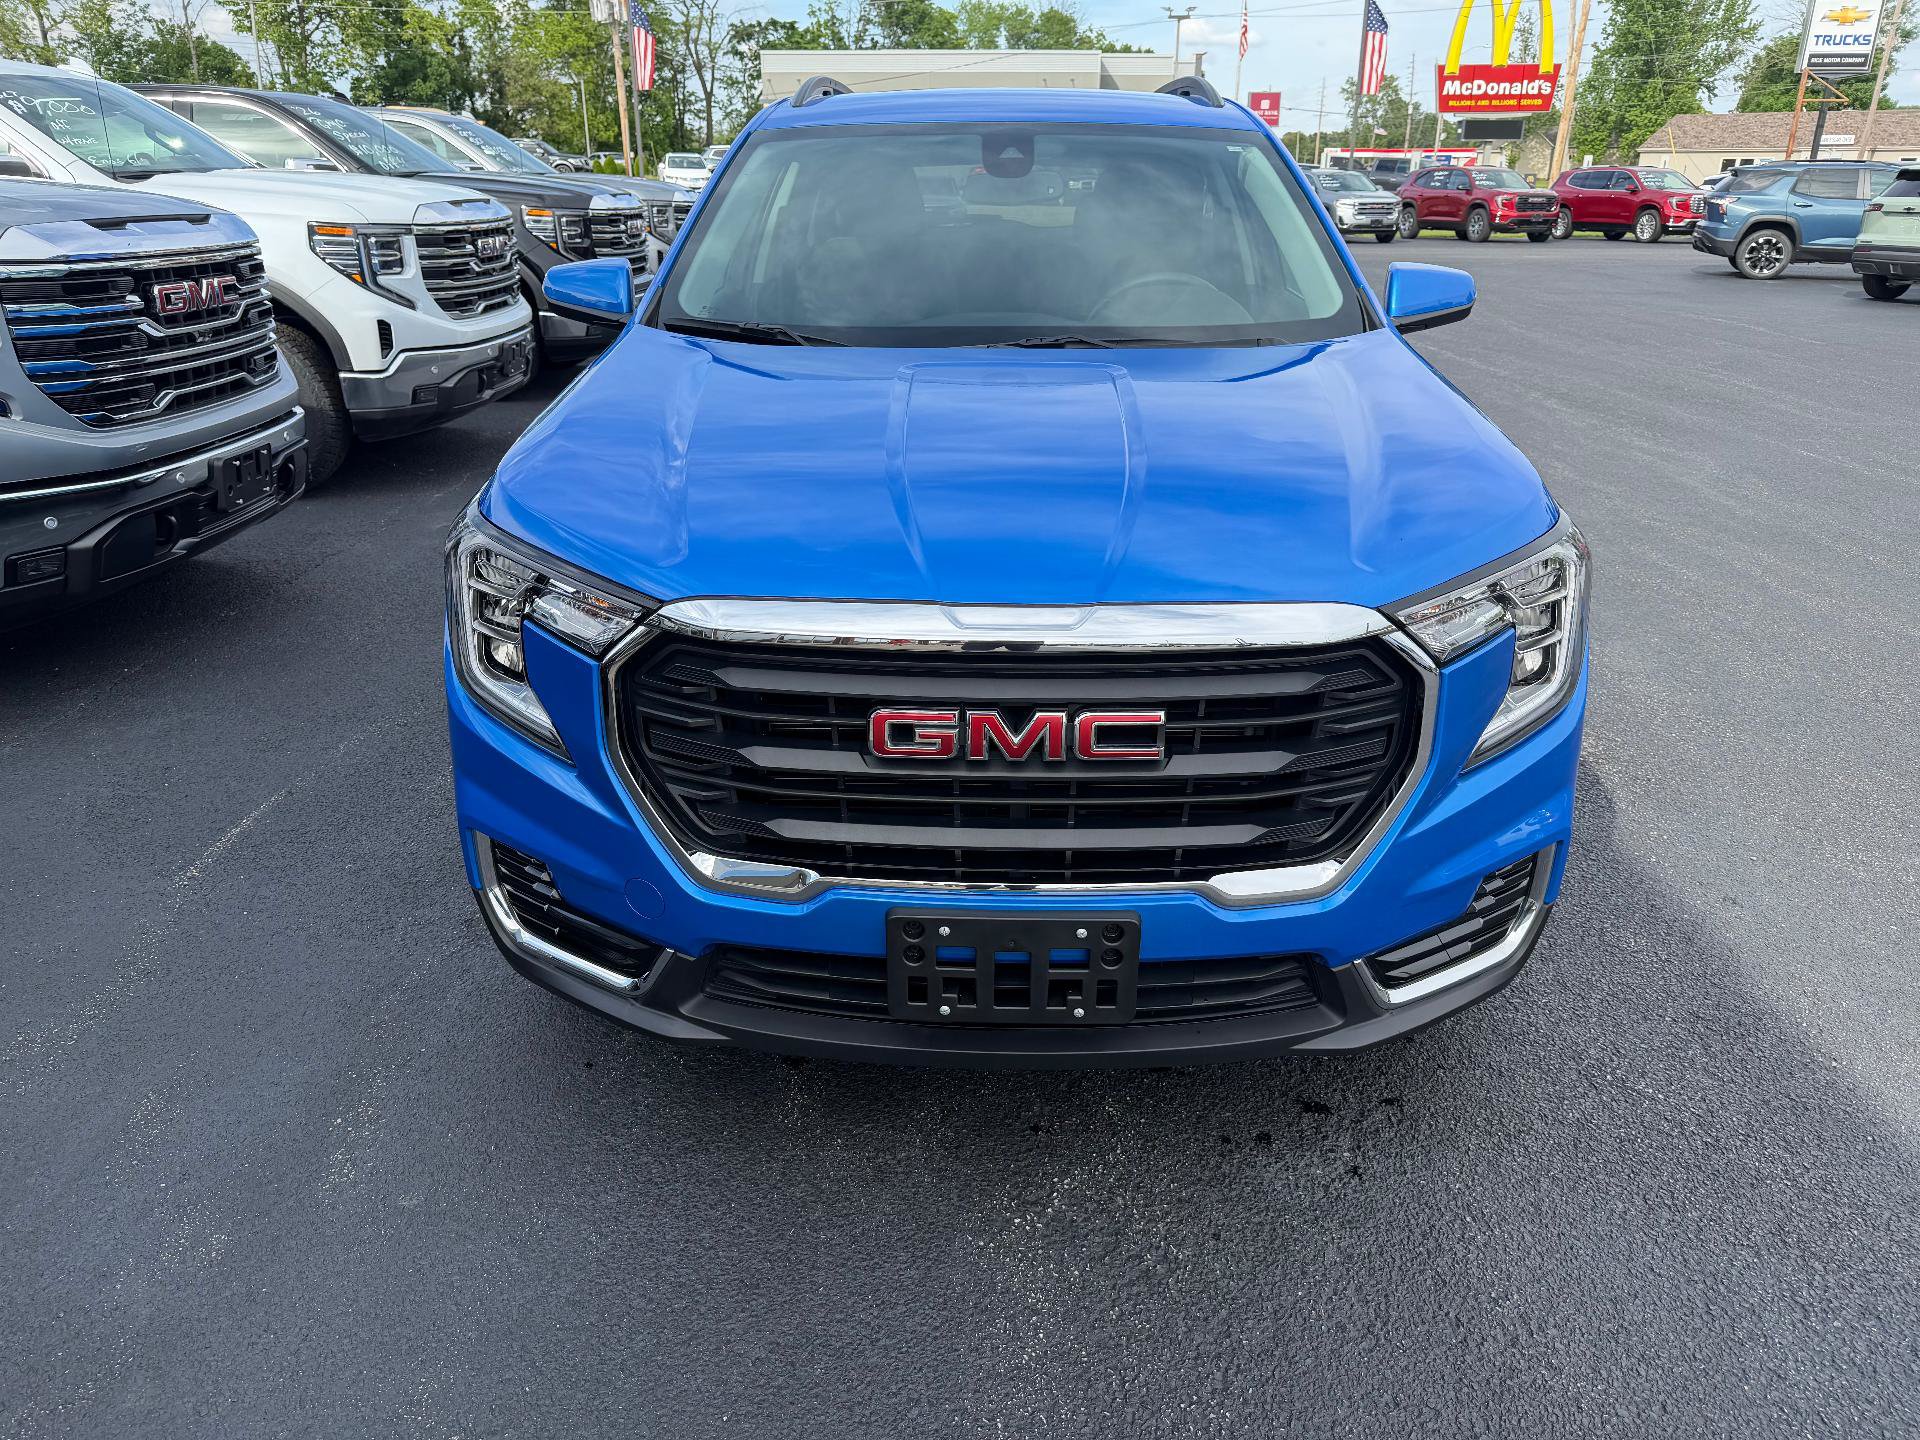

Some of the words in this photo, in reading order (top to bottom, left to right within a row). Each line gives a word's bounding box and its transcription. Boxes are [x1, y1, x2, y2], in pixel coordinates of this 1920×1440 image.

[1814, 34, 1872, 46] TRUCKS
[1442, 80, 1552, 96] McDonald's
[154, 276, 239, 316] GMC
[868, 707, 1167, 761] GMC
